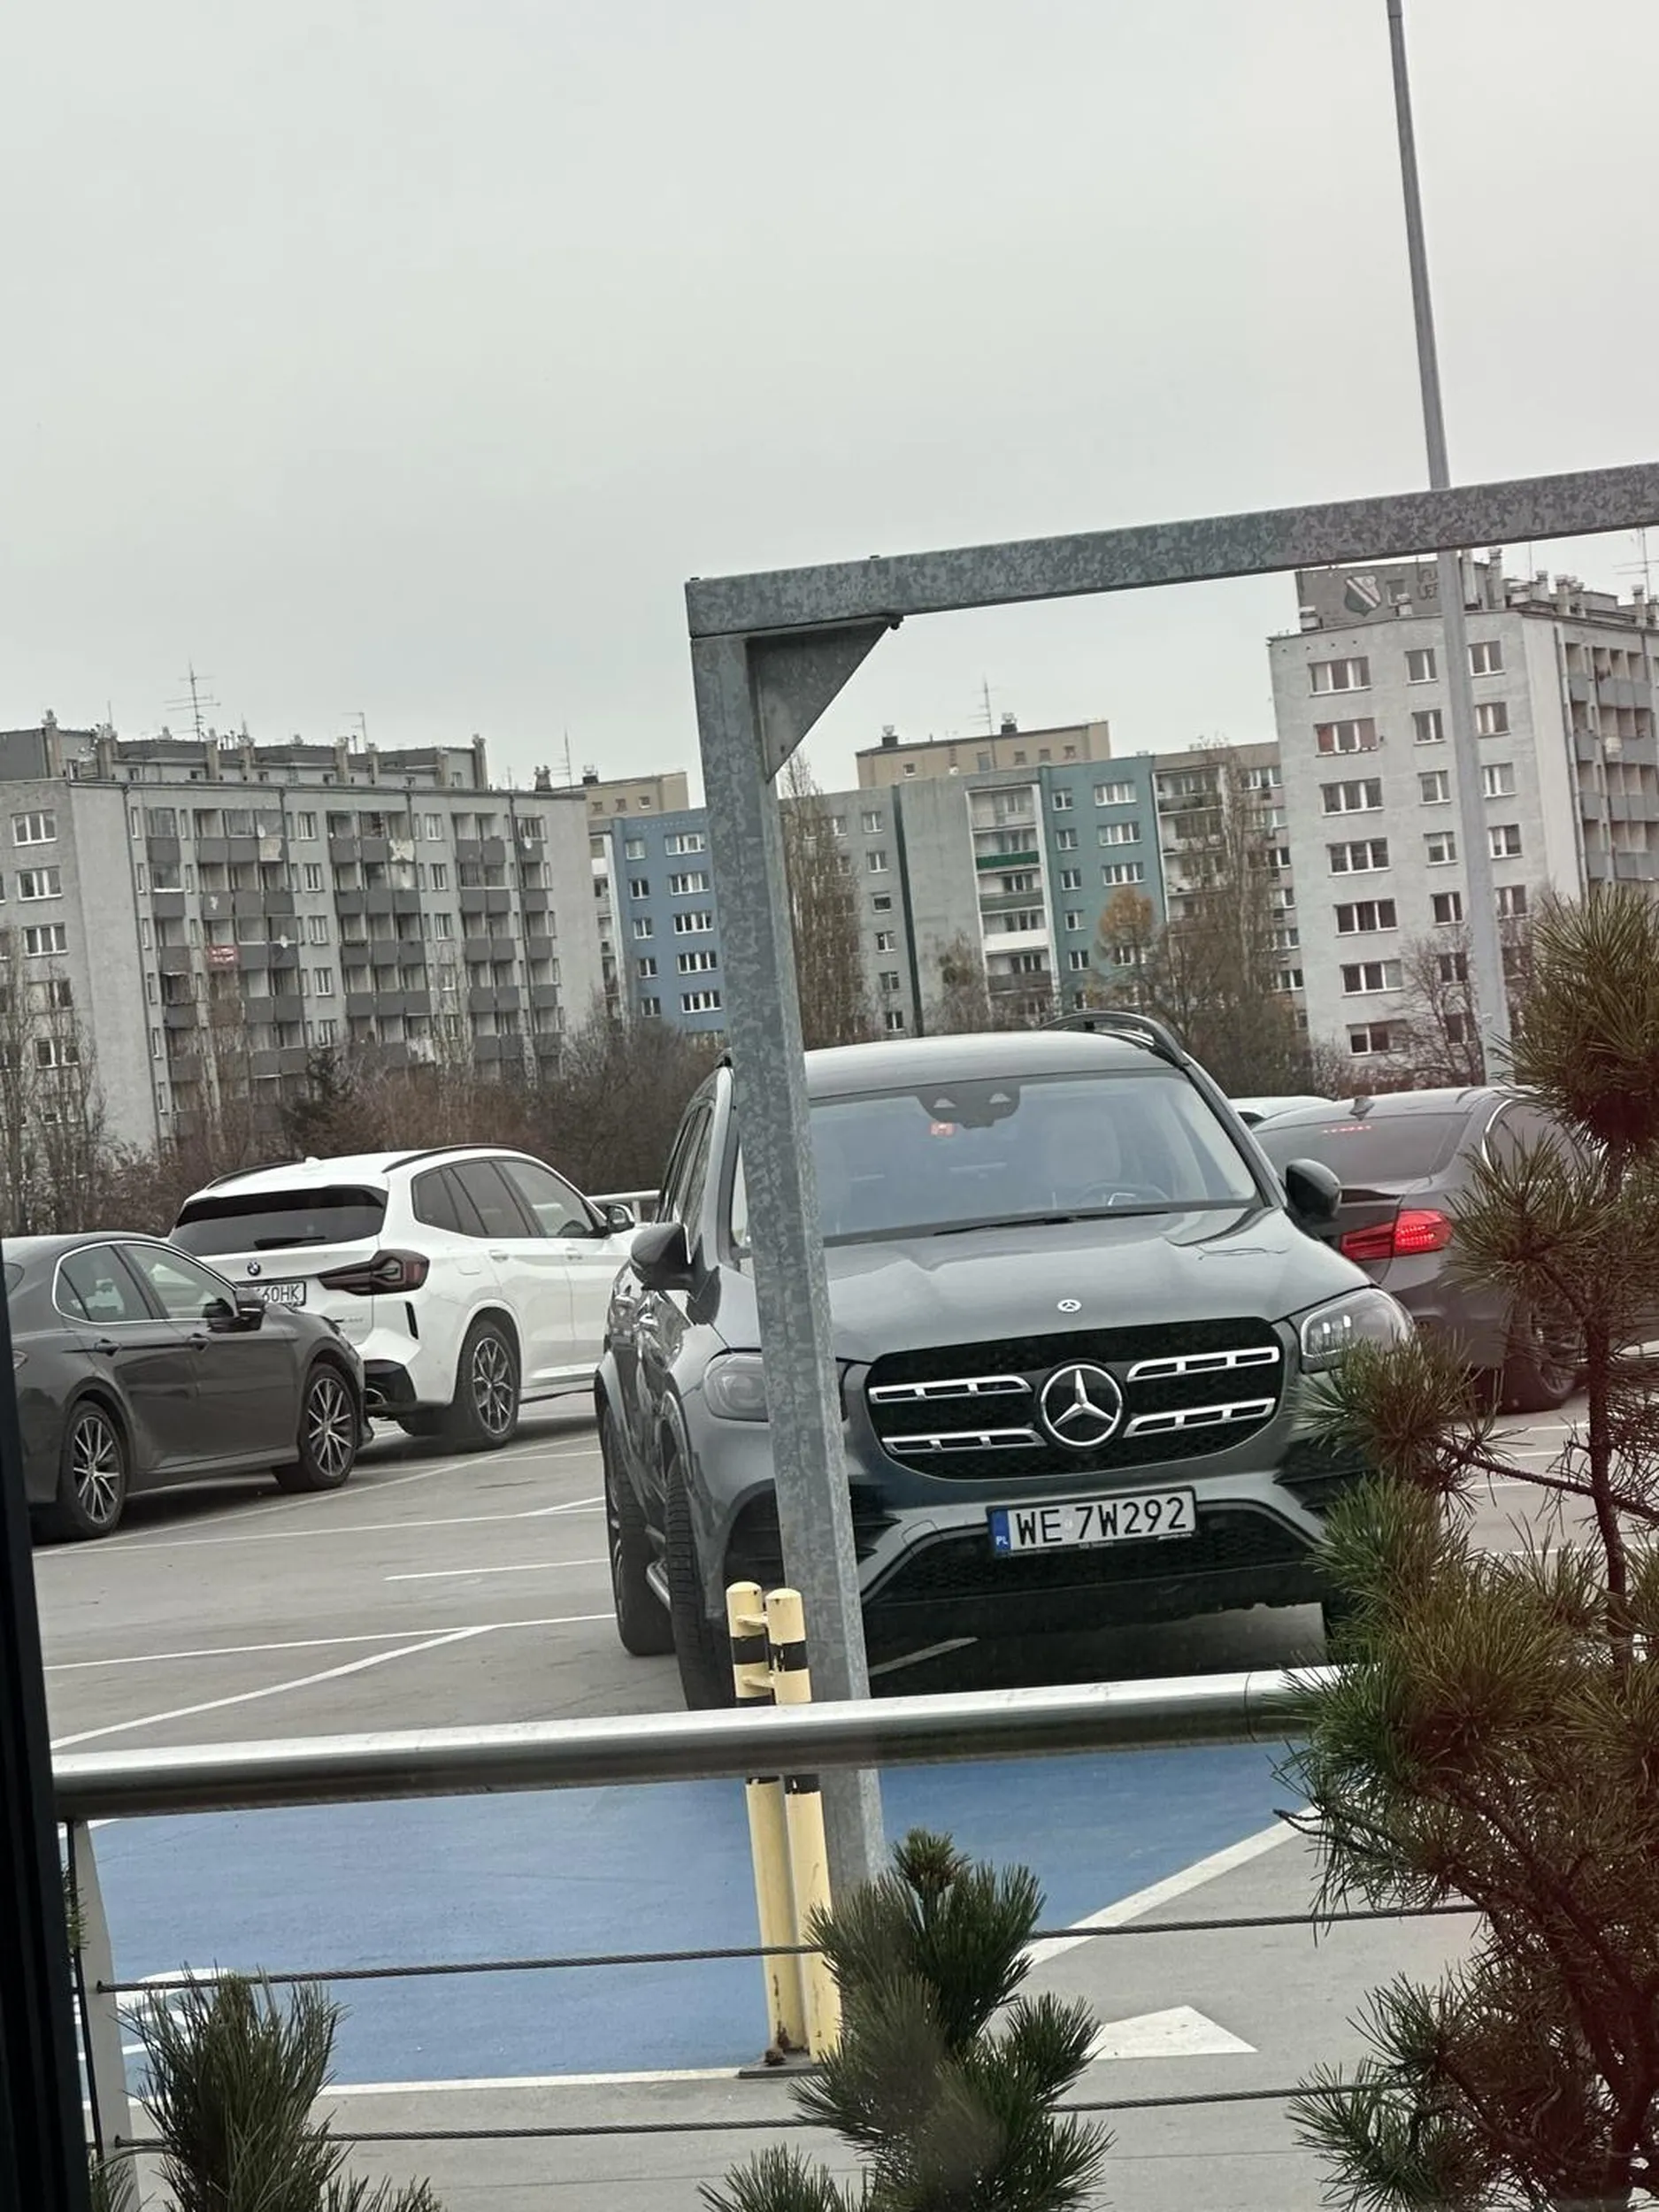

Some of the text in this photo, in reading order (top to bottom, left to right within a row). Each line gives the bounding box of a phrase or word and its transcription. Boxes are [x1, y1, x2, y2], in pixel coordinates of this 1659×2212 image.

[257, 1285, 299, 1302] 60HK
[1016, 1497, 1187, 1546] WE 7W292
[995, 1535, 1009, 1546] PL
